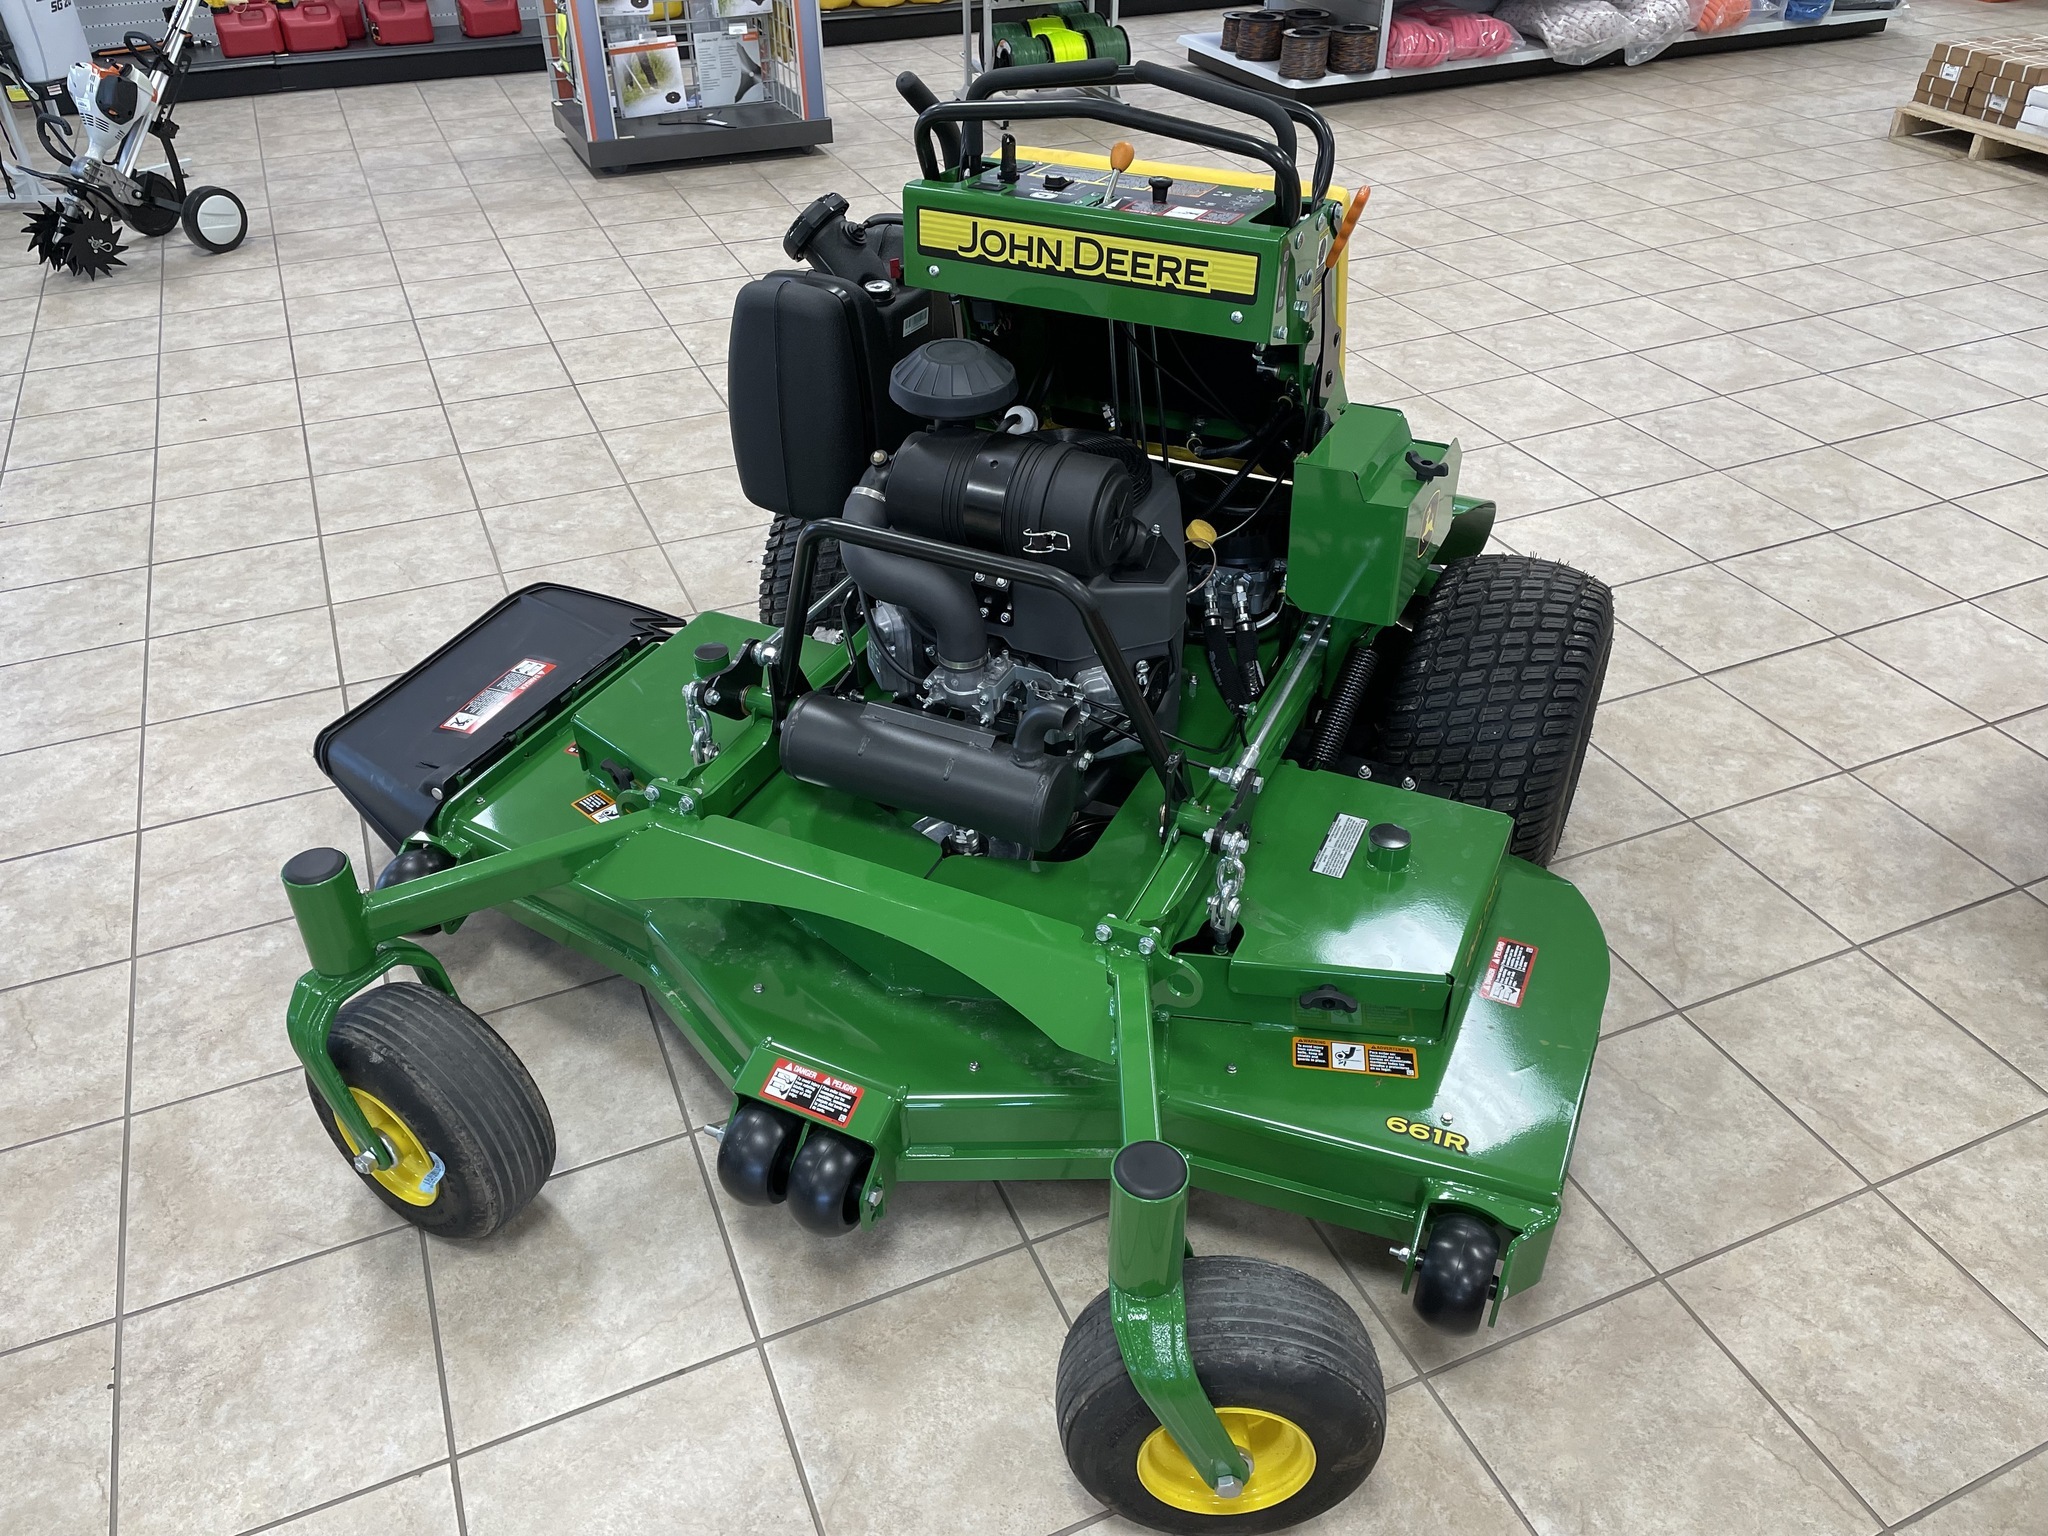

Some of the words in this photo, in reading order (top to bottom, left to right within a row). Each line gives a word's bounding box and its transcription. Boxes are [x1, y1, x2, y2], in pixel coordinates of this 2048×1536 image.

[51, 0, 63, 13] SG
[957, 220, 1065, 269] JOHN
[1073, 235, 1210, 290] DEERE
[793, 1064, 818, 1080] DANGER
[831, 1079, 858, 1094] PELIGRO
[1385, 1116, 1470, 1154] 661R
